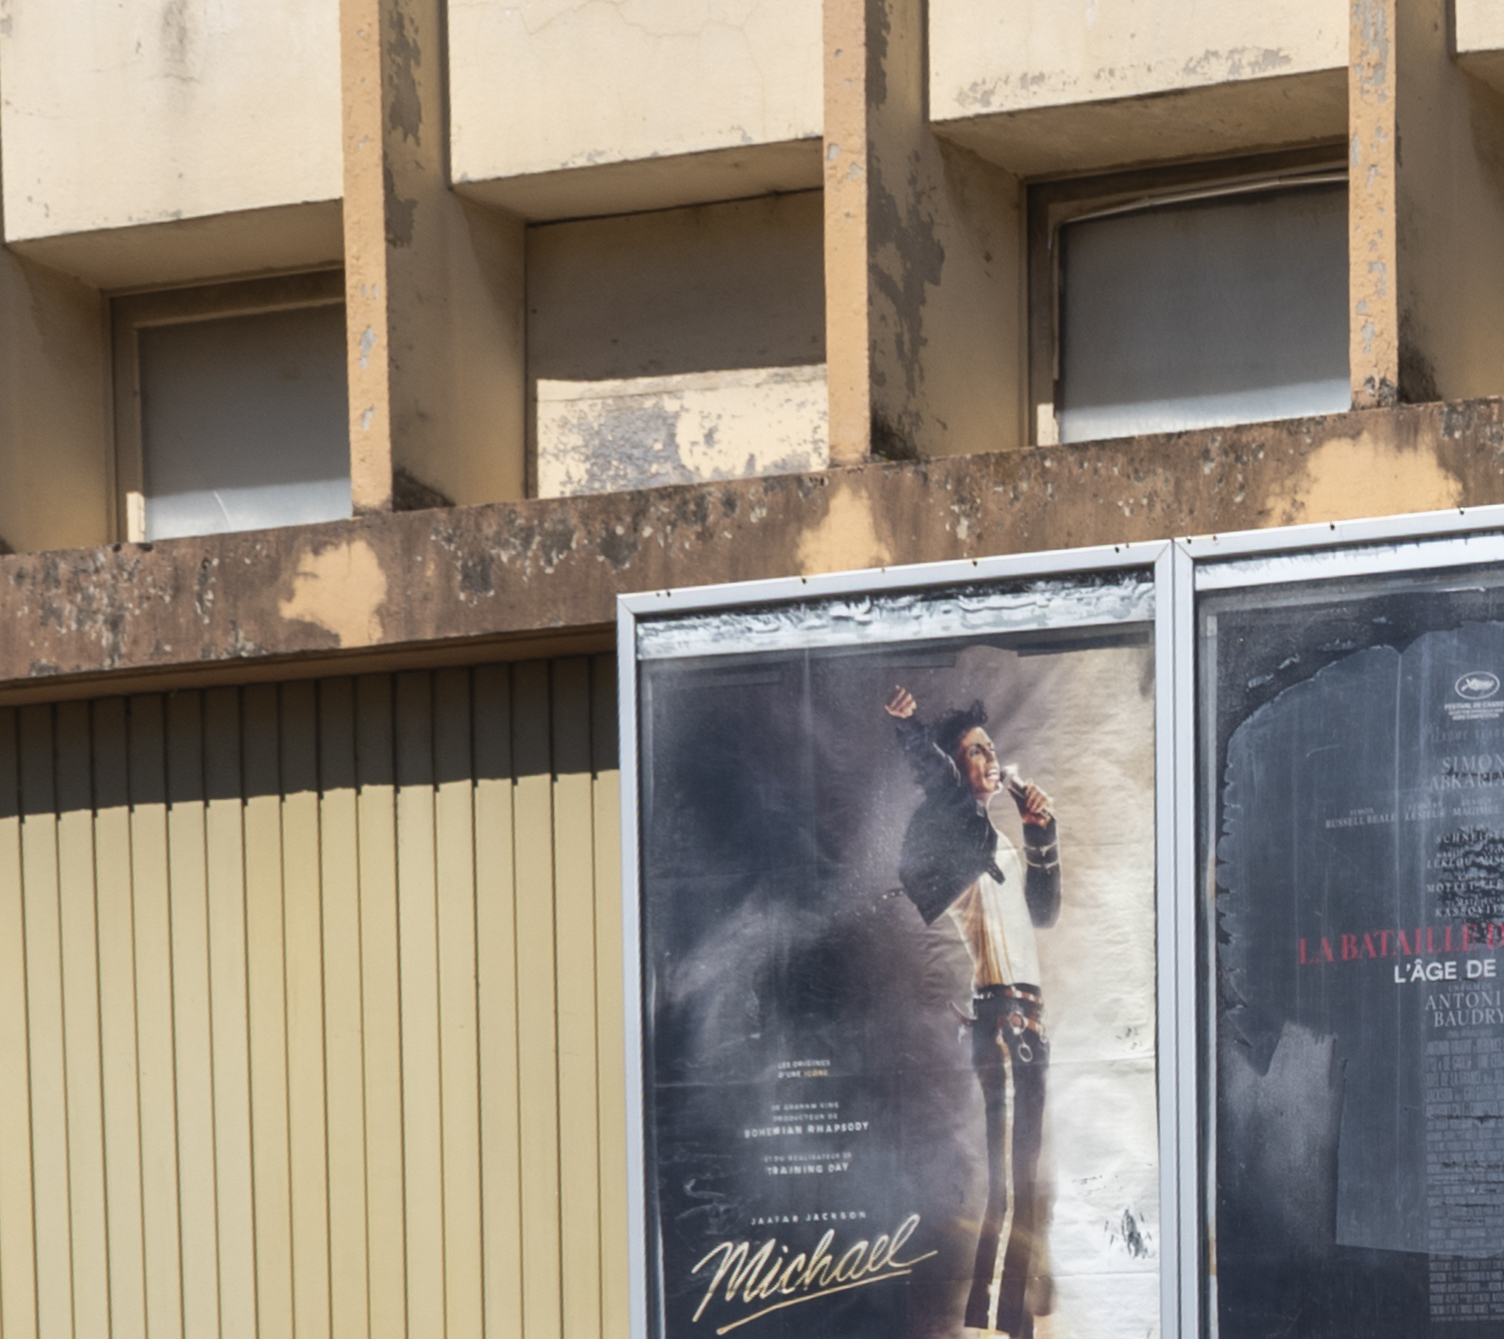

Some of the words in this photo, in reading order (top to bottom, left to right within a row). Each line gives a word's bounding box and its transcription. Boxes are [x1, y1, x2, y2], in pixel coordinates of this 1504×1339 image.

[1299, 938, 1334, 965] LA
[1341, 921, 1478, 961] BATAILLE
[1394, 959, 1457, 984] L'ÂGE
[1467, 959, 1496, 978] DE
[744, 1126, 803, 1138] BOHEMIAN
[807, 1122, 869, 1134] RHAPSODY
[767, 1165, 823, 1175] TRAINING
[828, 1163, 848, 1172] DAY
[805, 1211, 866, 1221] JACKSON
[691, 1214, 938, 1322] Michael
